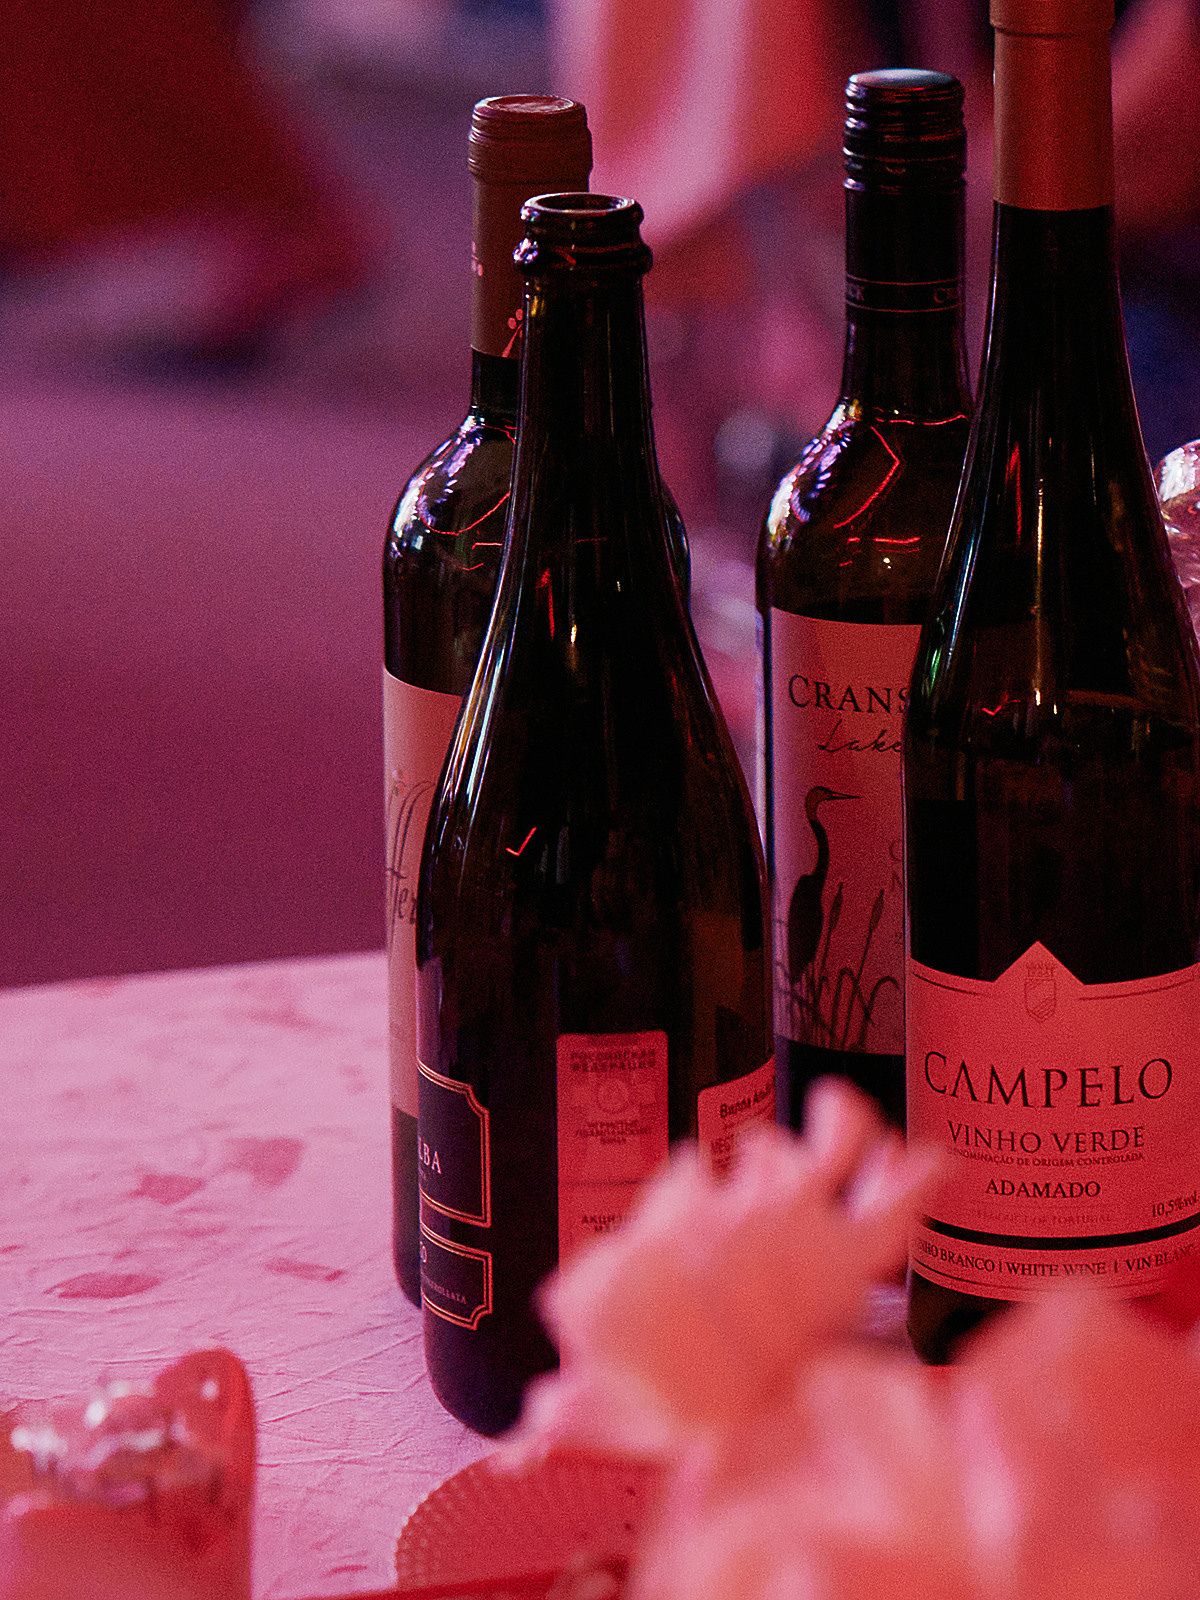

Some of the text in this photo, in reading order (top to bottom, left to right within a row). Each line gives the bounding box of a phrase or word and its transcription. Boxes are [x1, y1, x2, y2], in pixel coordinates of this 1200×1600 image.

[817, 718, 902, 753] Lake
[924, 1050, 1173, 1109] CAMPELO
[948, 1120, 1145, 1154] VINHO VERDE
[985, 1178, 1101, 1198] ADAMADO
[940, 1247, 996, 1272] BRANCO
[1005, 1261, 1060, 1277] WHITE
[1063, 1262, 1107, 1277] WINE
[1125, 1256, 1152, 1272] VIN
